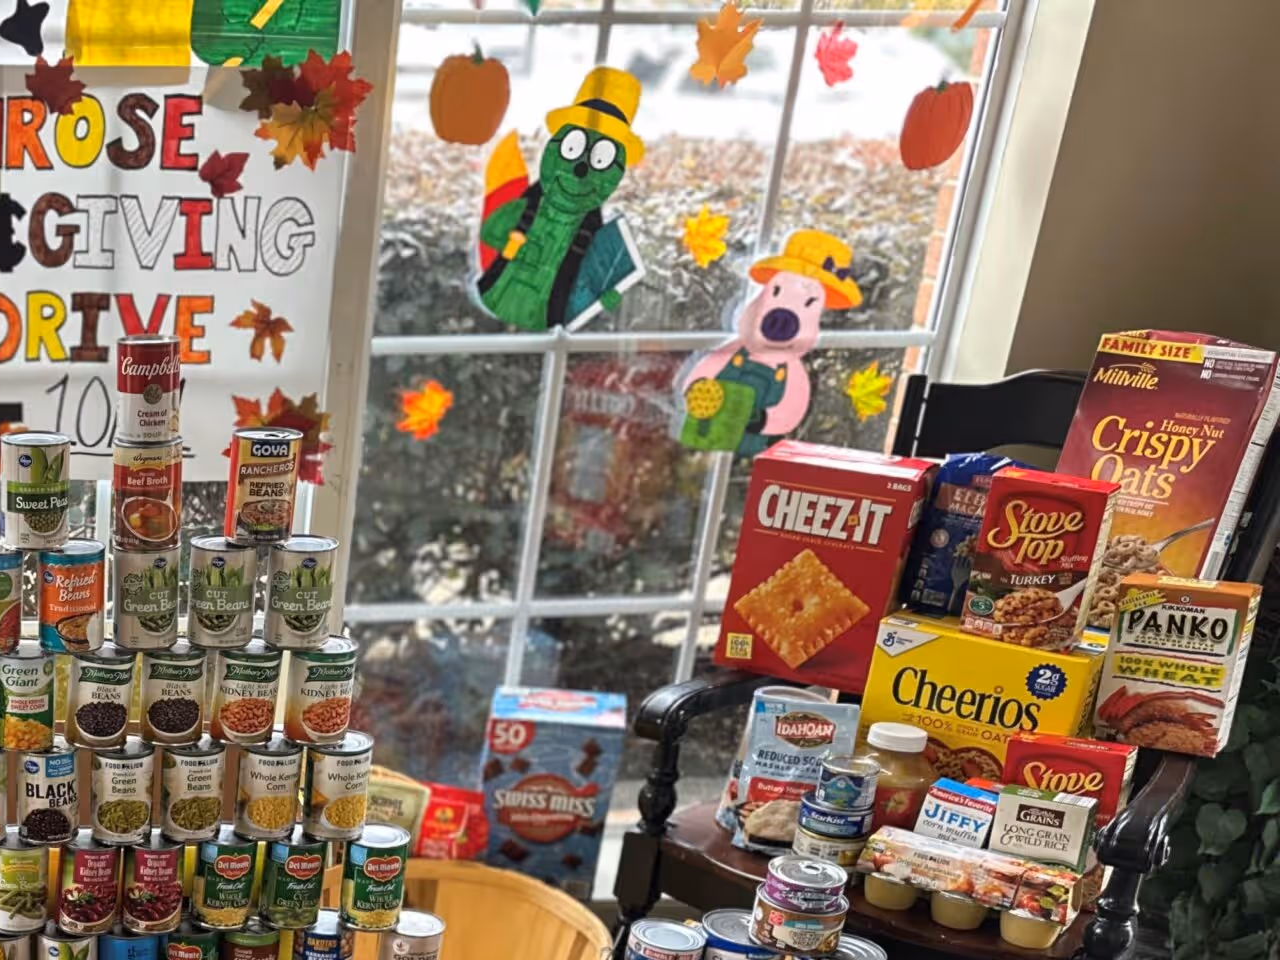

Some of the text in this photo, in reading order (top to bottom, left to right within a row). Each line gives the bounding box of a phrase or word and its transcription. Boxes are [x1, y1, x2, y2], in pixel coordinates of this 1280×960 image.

[1101, 337, 1192, 359] FAMILY SIZE
[1093, 367, 1159, 390] Millville
[1161, 419, 1225, 439] Honey Nut
[252, 445, 287, 456] GOYA
[1091, 415, 1217, 475] Crispy
[240, 461, 295, 475] RANCHEROS
[128, 477, 168, 485] Beef Broth
[1090, 452, 1176, 500] Oats
[16, 496, 48, 509] Sweet
[987, 500, 1085, 548] Stove
[1016, 532, 1065, 564] Top
[56, 573, 97, 591] Refried
[1009, 573, 1056, 586] TURKEY
[59, 589, 91, 602] Beans
[207, 591, 227, 599] CUT
[296, 591, 318, 599] CUT
[125, 600, 152, 612] Green
[272, 599, 300, 611] Green
[1162, 604, 1205, 614] KIKKOMAN
[1127, 608, 1228, 640] PANKO
[2, 663, 38, 677] Green
[1158, 660, 1221, 675] WHOLE
[6, 677, 39, 688] Giant
[1036, 668, 1060, 686] 2g
[1118, 665, 1219, 686] WHEAT
[92, 692, 120, 700] BEANS
[161, 689, 191, 697] BEANS
[301, 689, 337, 697] KIDNEY
[891, 666, 1041, 731] Cheerios
[493, 724, 527, 744] 50
[775, 719, 836, 740] IDAHOAN
[757, 749, 800, 764] REDUCED
[112, 777, 136, 785] Green
[187, 774, 211, 782] Green
[250, 772, 277, 781] Whole
[328, 772, 354, 781] Whole
[1023, 761, 1104, 794] Stove
[26, 781, 75, 799] BLACK
[112, 786, 136, 794] Beans
[188, 782, 211, 791] Beans
[267, 782, 286, 790] Corn
[49, 793, 77, 808] BEANS
[930, 788, 994, 813] America's Favorite
[924, 803, 986, 833] JIFFY
[1020, 814, 1060, 827] GRAINS
[946, 826, 978, 842] muffin
[1003, 824, 1071, 842] LONG GRAIN
[1043, 839, 1068, 851] RICE
